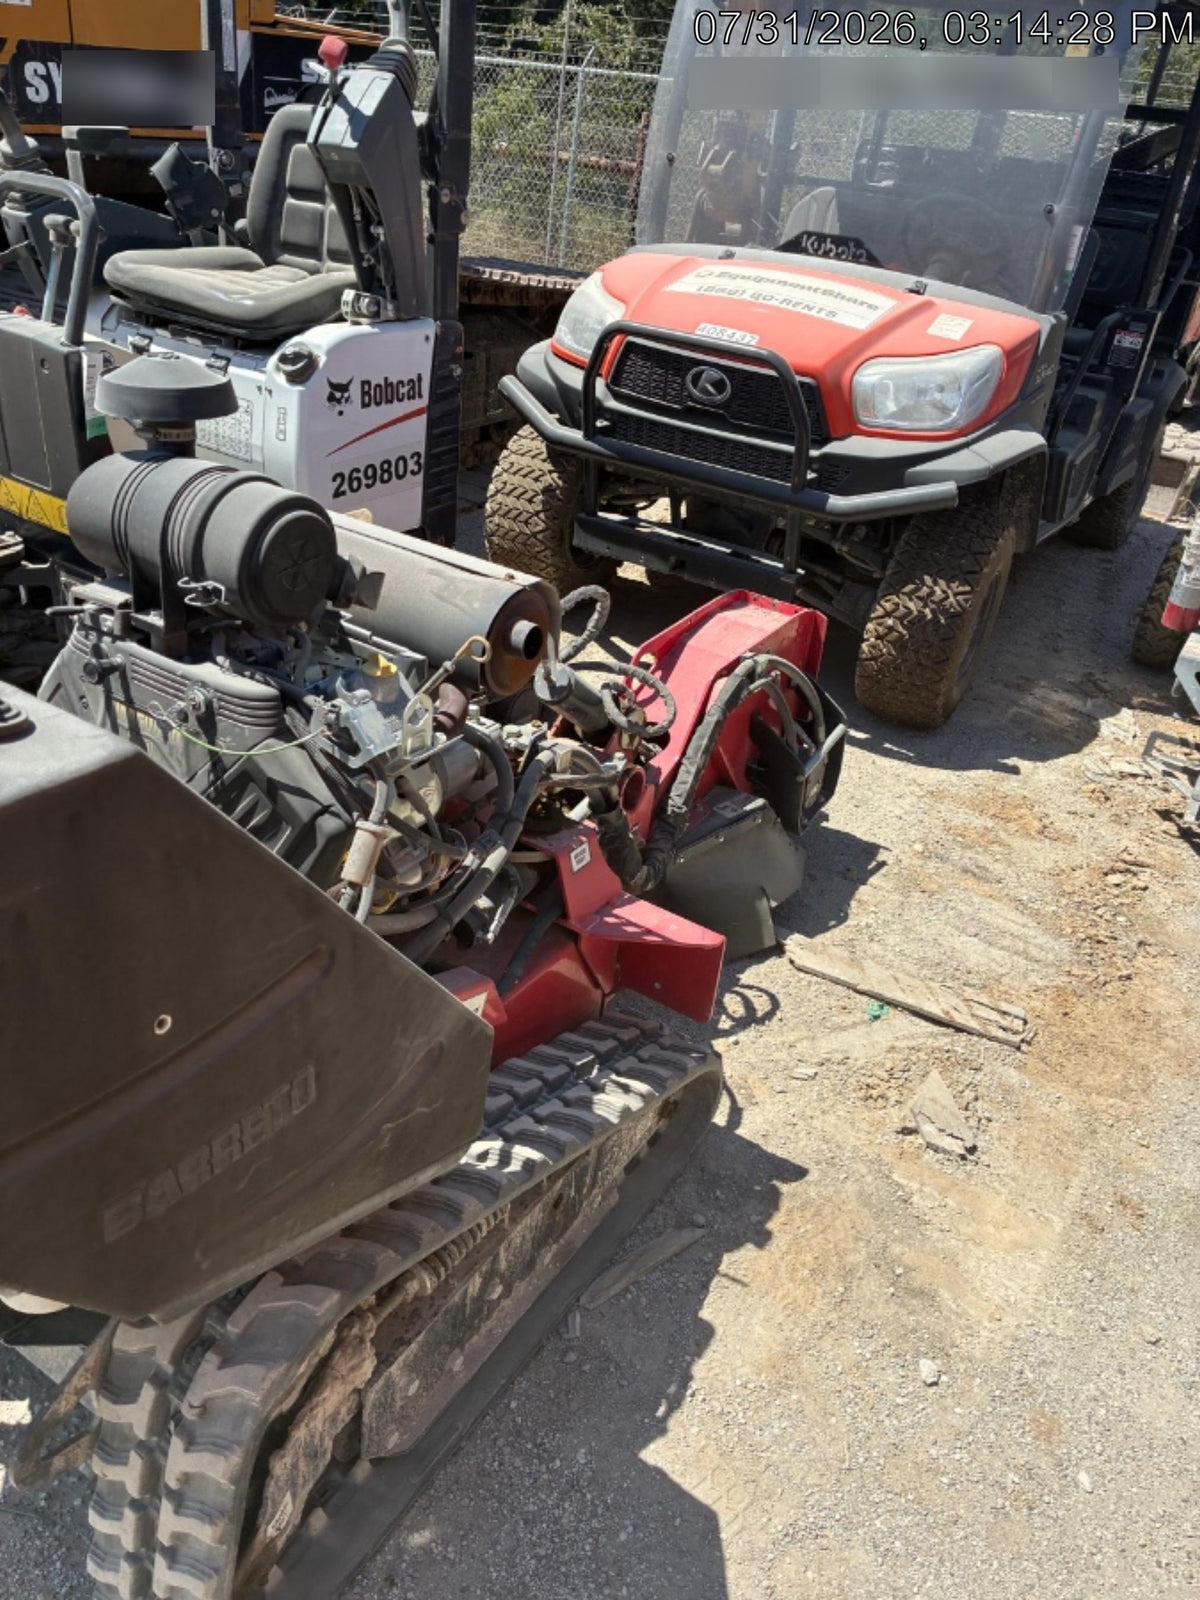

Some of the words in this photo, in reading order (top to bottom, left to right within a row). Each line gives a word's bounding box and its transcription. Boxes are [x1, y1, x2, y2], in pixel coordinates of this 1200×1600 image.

[801, 234, 869, 262] Kubota
[360, 373, 423, 409] Bobcat
[331, 451, 423, 500] 269803
